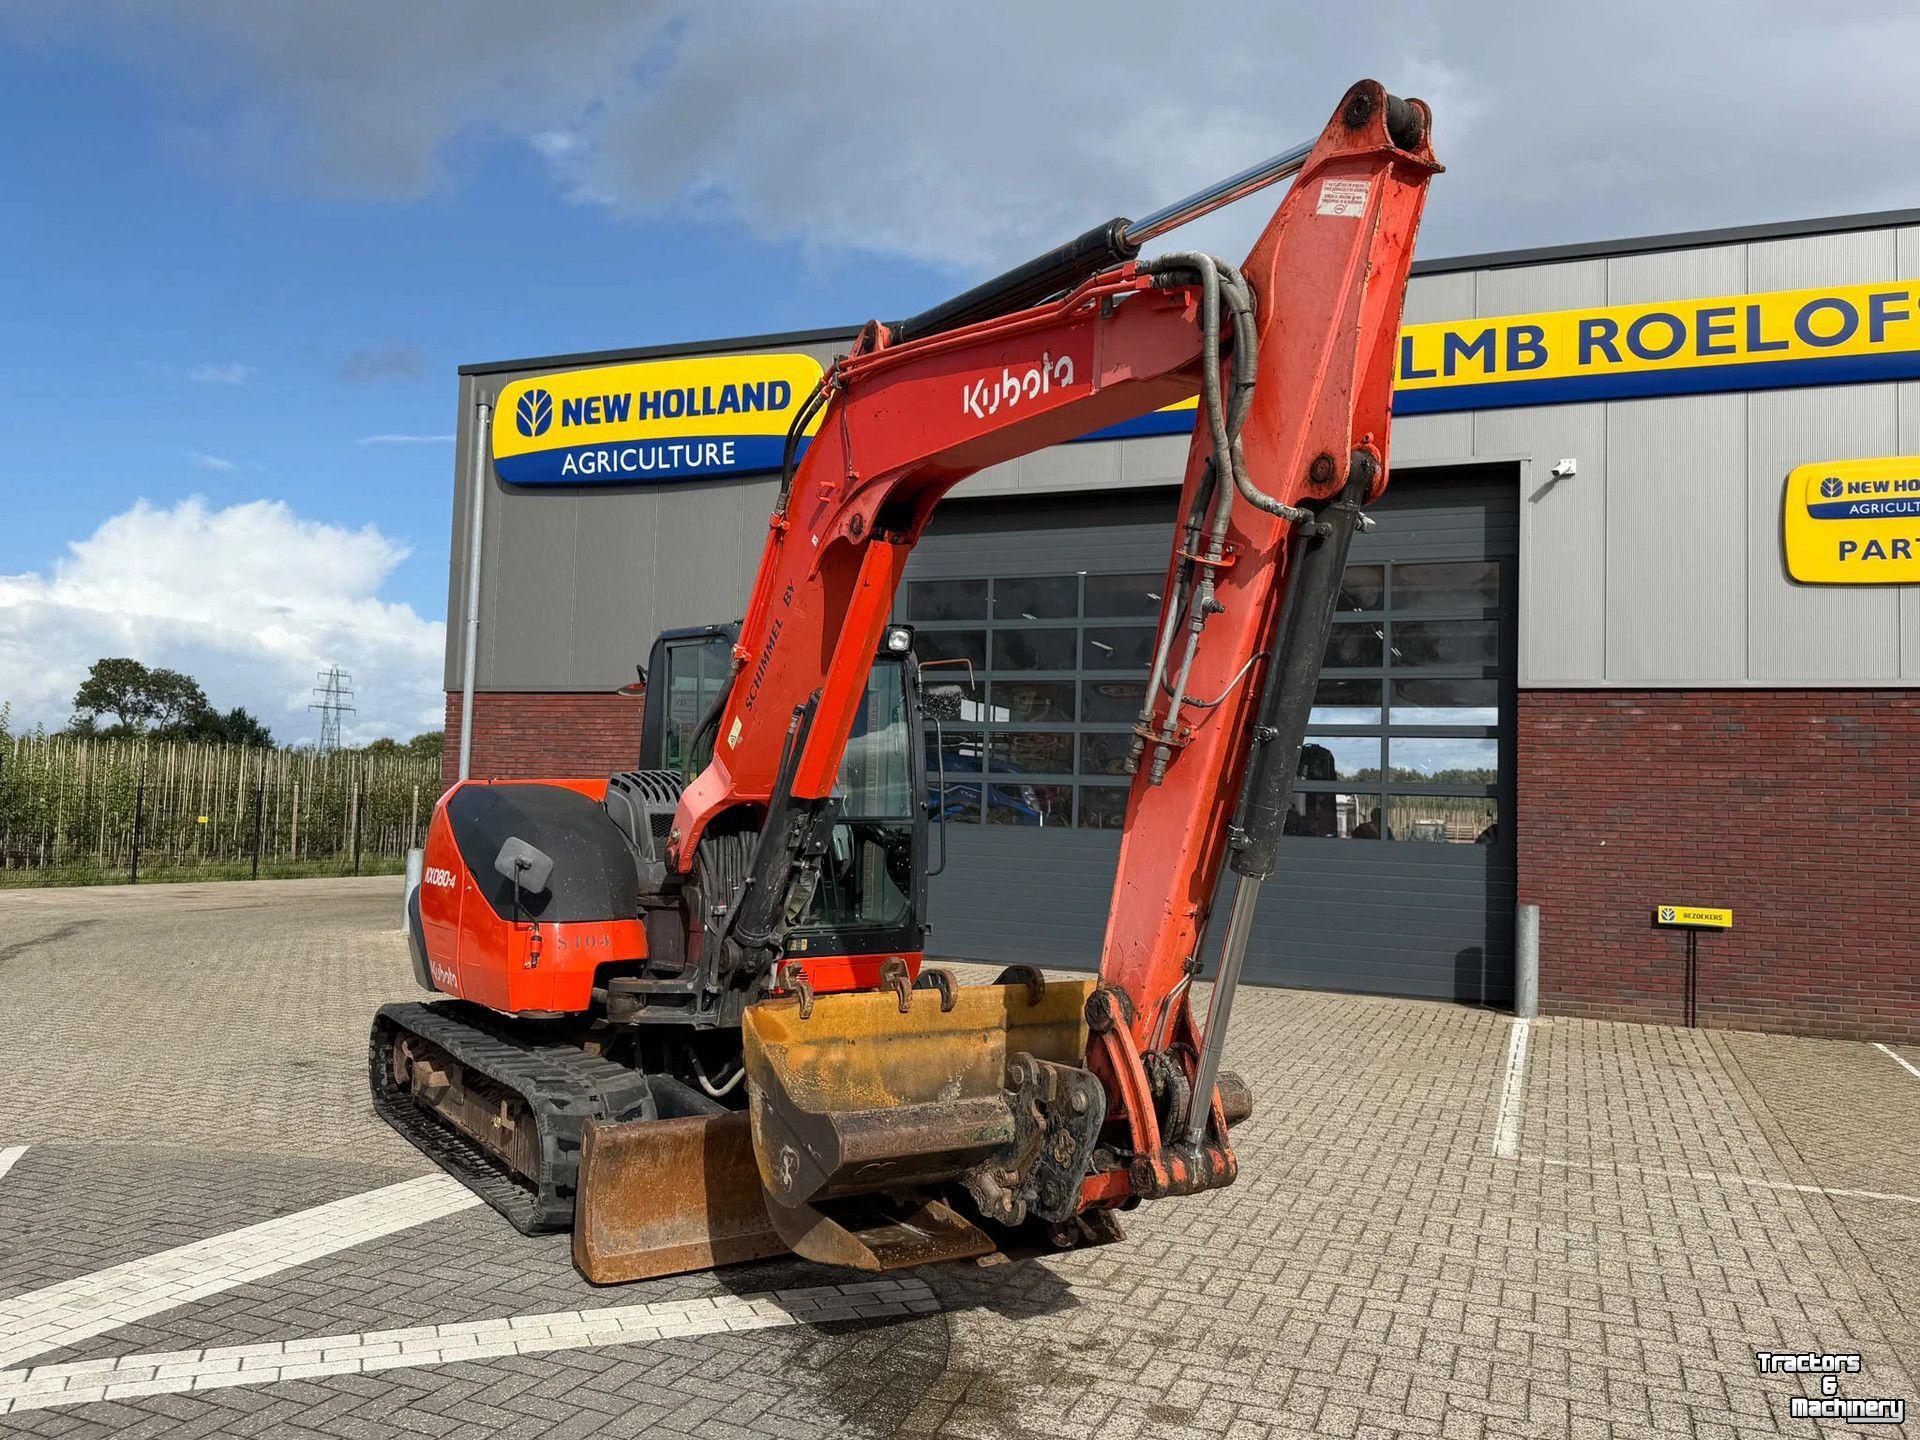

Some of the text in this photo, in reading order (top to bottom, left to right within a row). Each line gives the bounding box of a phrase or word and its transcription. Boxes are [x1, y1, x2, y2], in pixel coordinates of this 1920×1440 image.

[1400, 290, 1920, 380] LMB ROELOF
[561, 380, 791, 427] NEW HOLLAND
[963, 351, 1074, 419] Kubota
[561, 441, 736, 476] AGRICULTURE
[1847, 480, 1890, 494] NEW
[745, 618, 784, 712] SCHIMMEL
[1683, 912, 1723, 921] BEZOEKERS
[430, 960, 459, 991] Kubota
